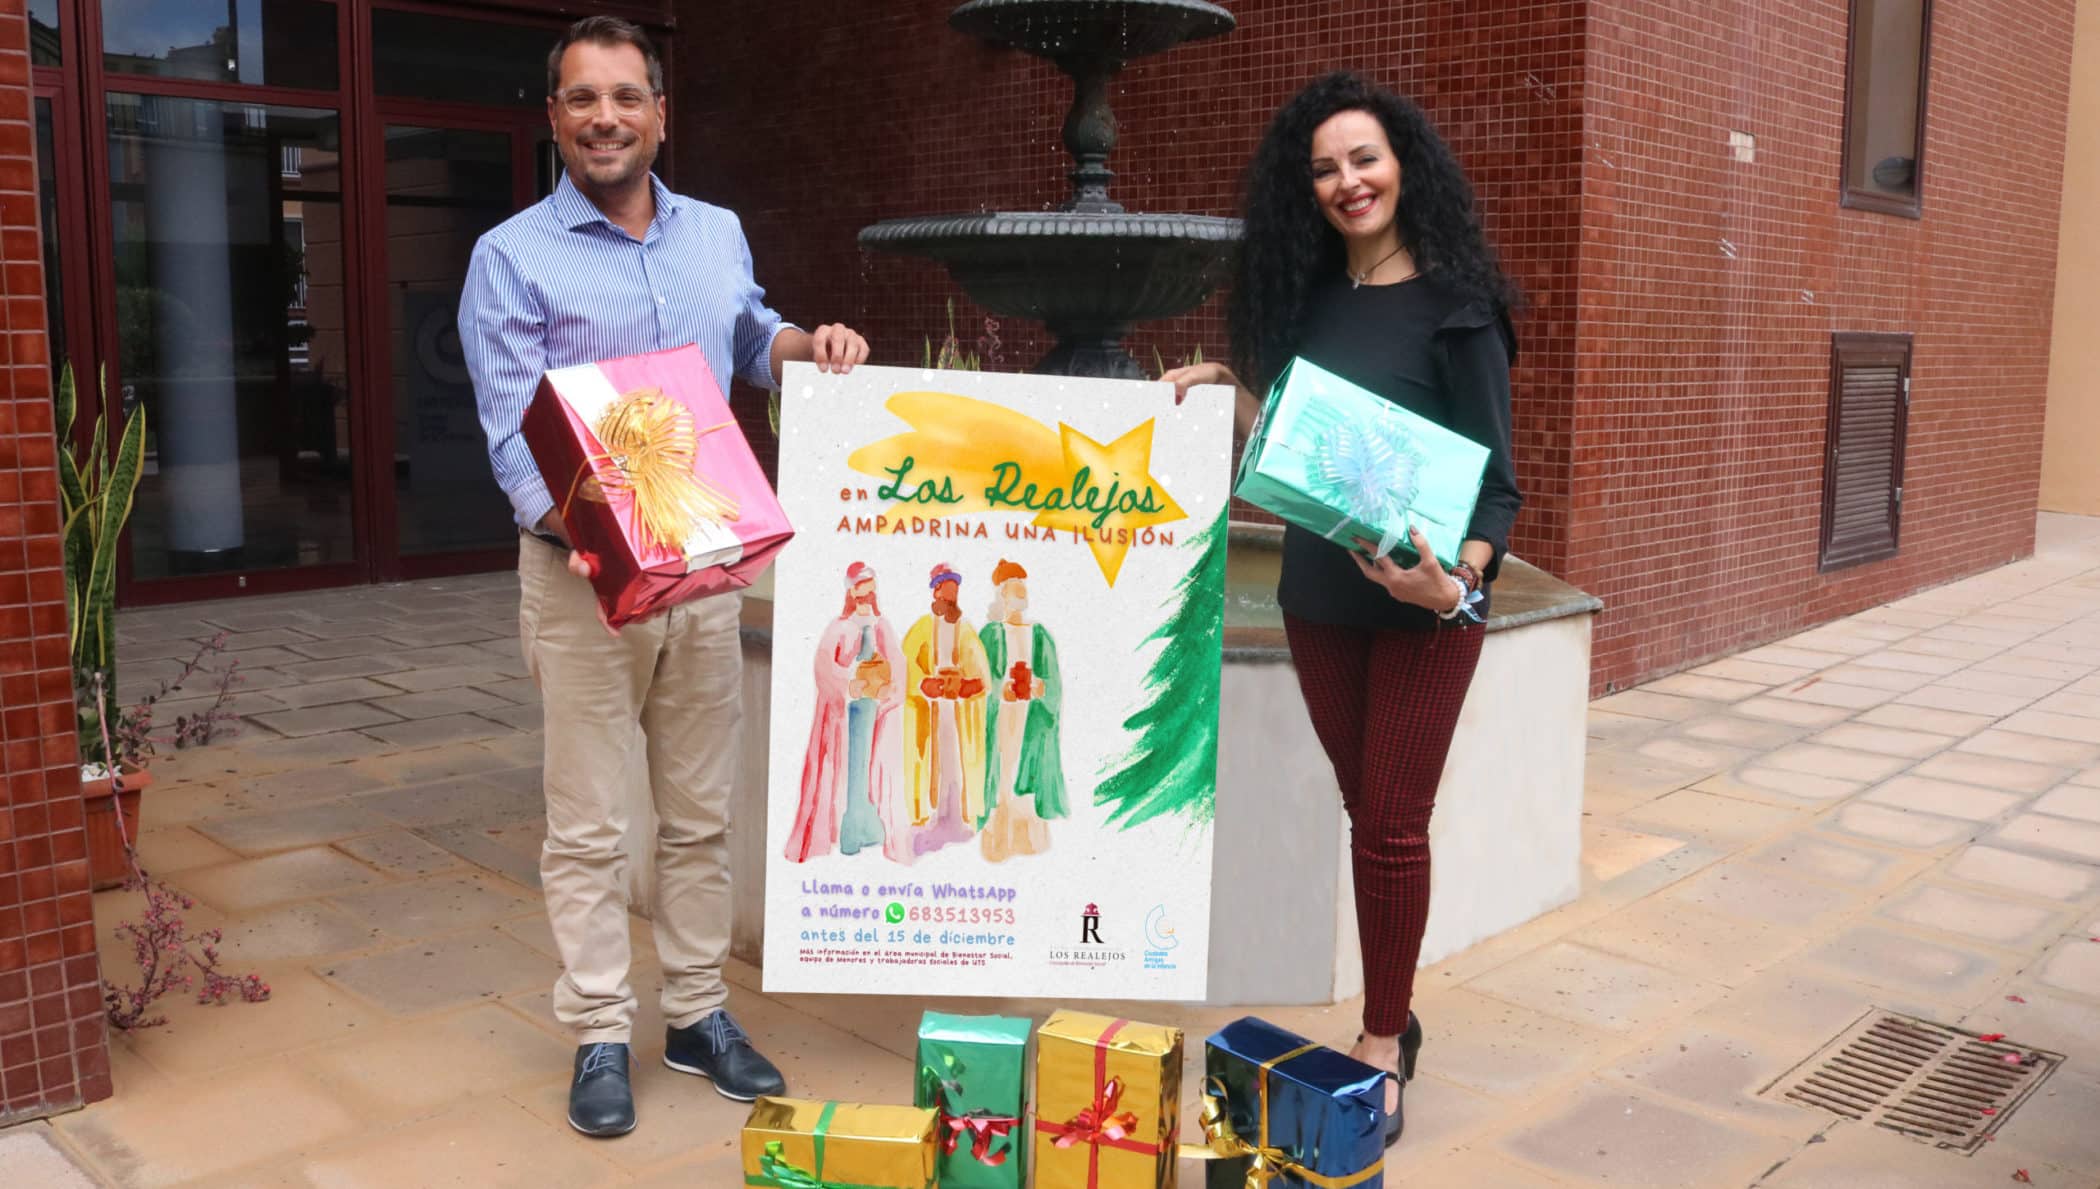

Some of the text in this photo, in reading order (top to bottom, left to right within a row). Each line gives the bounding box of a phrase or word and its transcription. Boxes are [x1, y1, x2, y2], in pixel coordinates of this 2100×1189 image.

[840, 456, 1165, 530] en Los Realejos
[836, 516, 1174, 547] AMPADRINA UNA ILUSIÓN
[802, 879, 1017, 903] Llama o envía WhatsApp
[801, 904, 1015, 925] a número 683513953
[801, 928, 1015, 945] antes del 15 de diciembre
[817, 948, 860, 957] información
[884, 949, 902, 957] área
[1049, 951, 1126, 961] LOS REALEJOS
